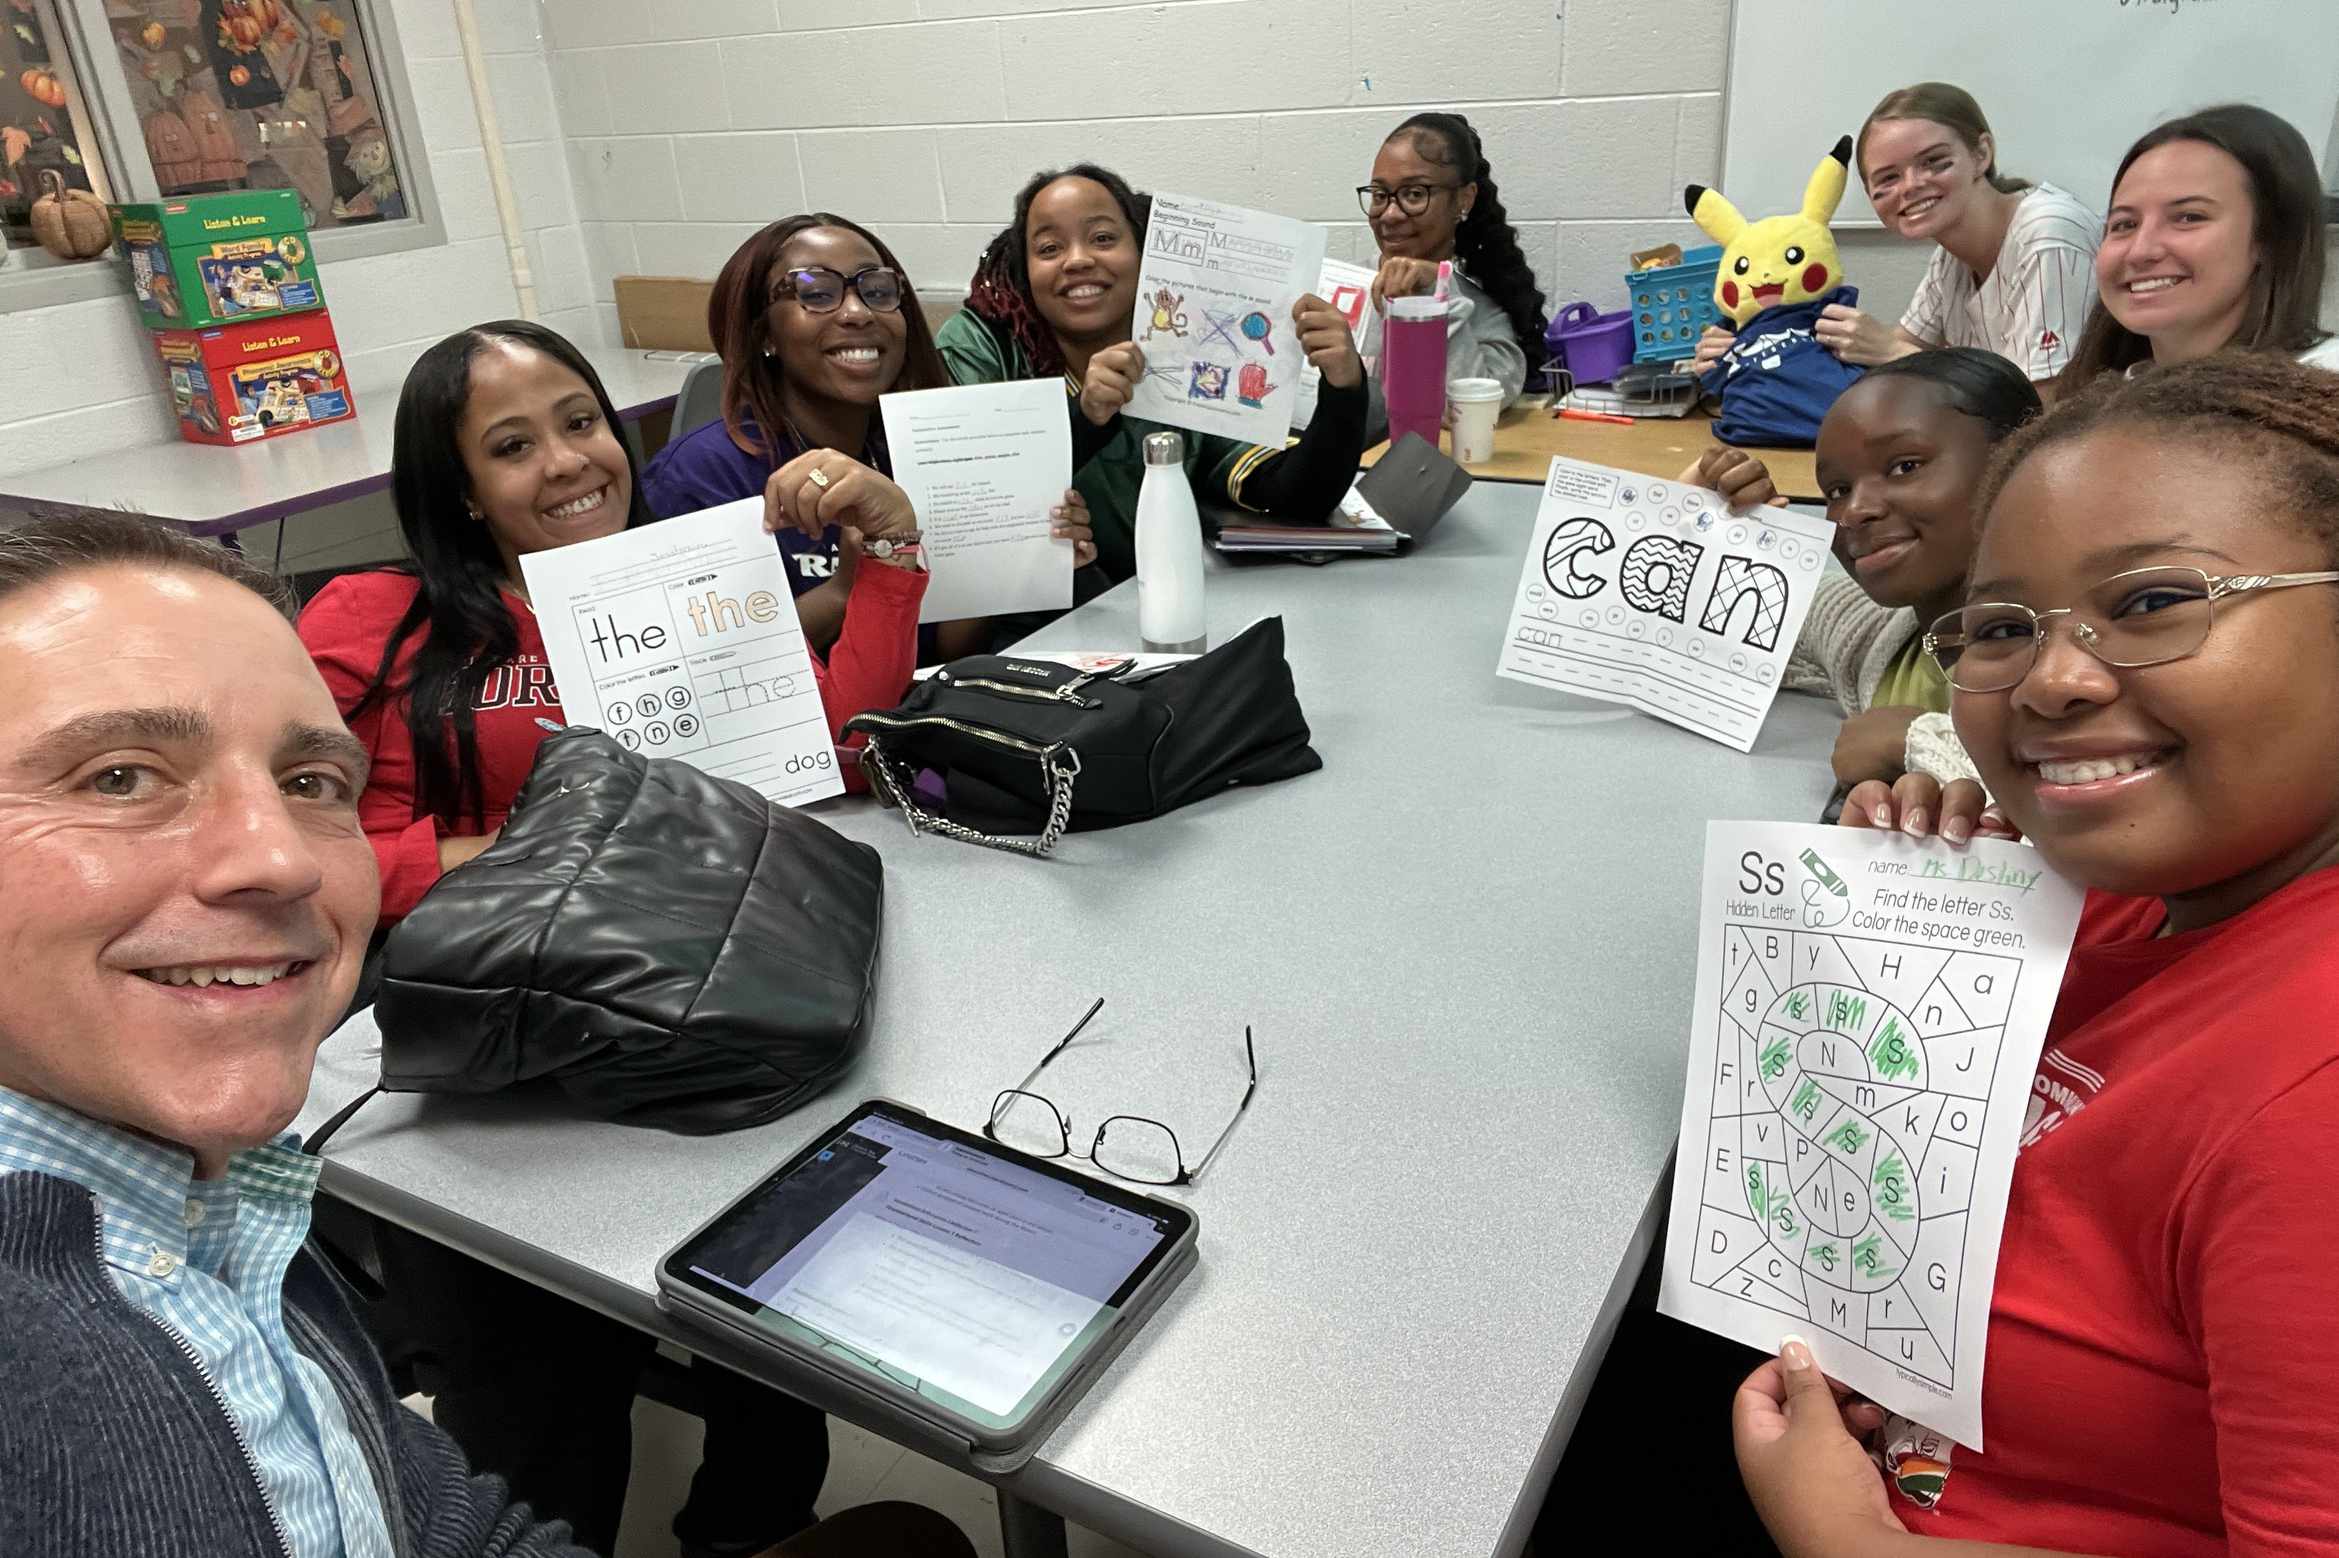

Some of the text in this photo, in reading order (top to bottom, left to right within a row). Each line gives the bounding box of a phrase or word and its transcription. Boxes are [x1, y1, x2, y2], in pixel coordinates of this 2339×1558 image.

[203, 215, 266, 230] Listen & Learn
[1153, 209, 1216, 229] Beginning Sound
[242, 335, 301, 352] Listen & Learn
[1543, 517, 1789, 653] can
[688, 590, 779, 637] the
[590, 614, 667, 663] the
[1518, 626, 1563, 648] can
[616, 690, 686, 721] f h g
[653, 726, 665, 740] n
[680, 718, 692, 731] e
[784, 750, 831, 775] dog
[1739, 850, 1785, 896] Ss
[1726, 899, 1796, 920] Hidden Letter
[1873, 888, 2014, 921] Find the letter Ss.
[1852, 910, 2027, 949] Color the space green.
[1766, 935, 1779, 959] B
[1880, 953, 1902, 980] H
[1974, 973, 1994, 996] a
[1746, 989, 1758, 1012] g
[1925, 1002, 1942, 1026] n
[1821, 1041, 1835, 1068] N
[1955, 1047, 1975, 1073] J
[1720, 1064, 1734, 1086] F
[1747, 1079, 1756, 1098] r
[1855, 1086, 1876, 1109] m
[1716, 1148, 1730, 1171] E
[1940, 1167, 1947, 1194] i
[1814, 1183, 1828, 1212] N
[1843, 1192, 1855, 1212] e
[1711, 1230, 1728, 1254] D
[1928, 1263, 1946, 1291] G
[1830, 1299, 1847, 1328] M
[1884, 1299, 1892, 1319] r
